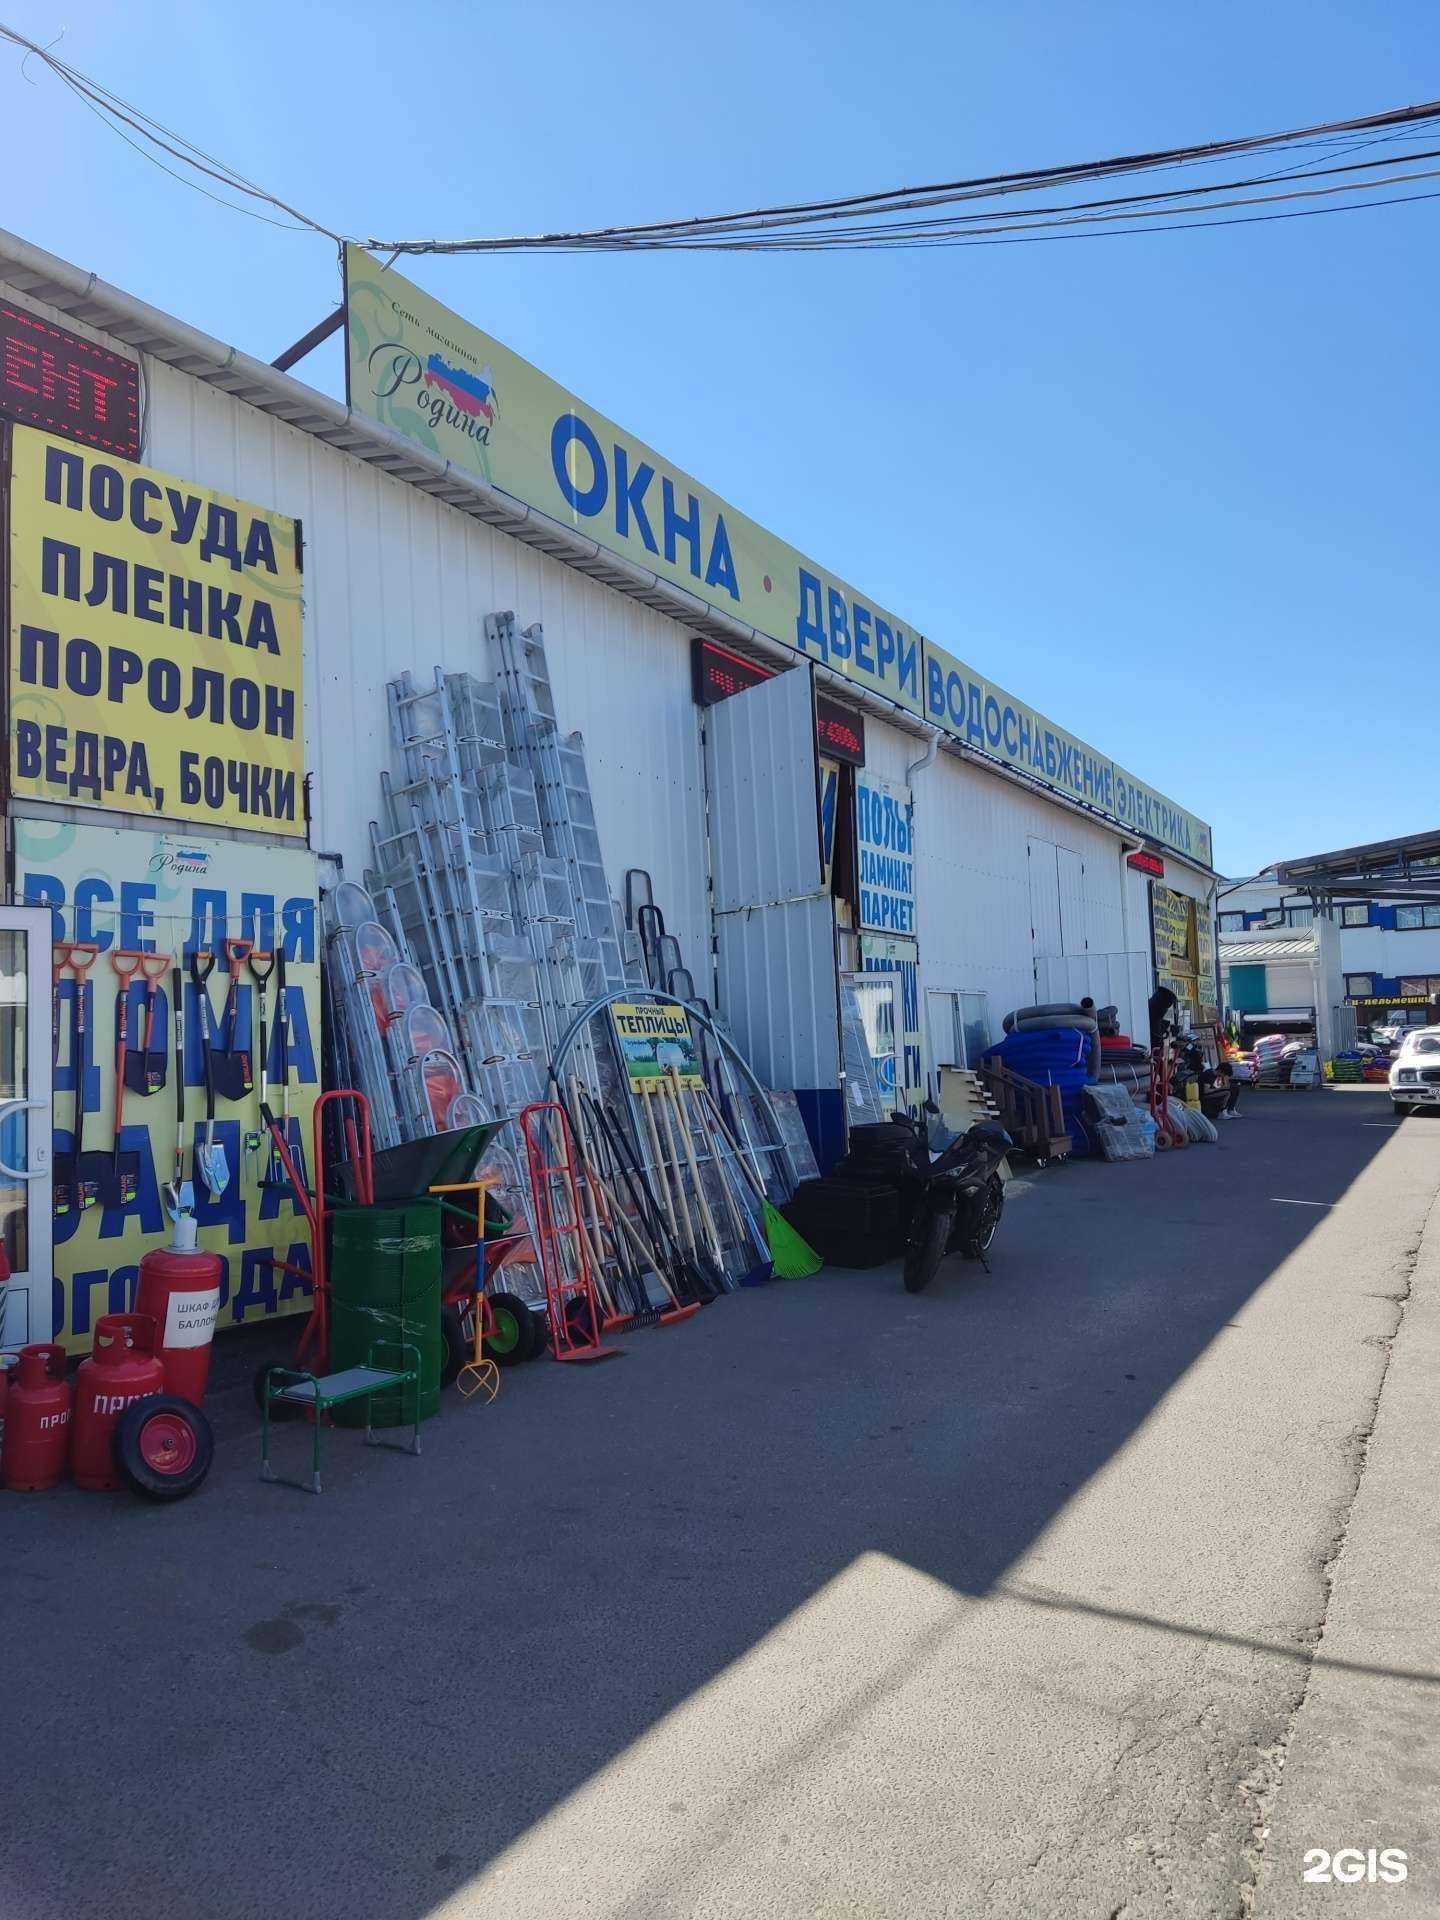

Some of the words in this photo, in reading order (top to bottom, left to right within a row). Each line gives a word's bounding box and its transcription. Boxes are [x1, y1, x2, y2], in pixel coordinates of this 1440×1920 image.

[367, 342, 492, 447] Родина
[44, 445, 279, 575] ПОСУДА
[41, 537, 281, 656] ПЛЕНКА
[550, 412, 741, 602] ОКНА
[796, 566, 918, 700] ДВЕРИ
[927, 655, 1113, 808] ВОДОСНАБЖЕНИЕ
[1115, 779, 1192, 853] ЭЛЕКТРИКА
[19, 624, 295, 740] ПОРОЛОН
[16, 719, 165, 811] ВЕДРА,
[179, 751, 296, 822] БОЧКИ
[857, 785, 912, 855] ПОЛЫ
[860, 849, 913, 894] ЛАМИНАТ
[860, 892, 914, 932] ПАРКЕТ
[23, 873, 157, 955] ВСЕ
[182, 888, 315, 973] ДЛЯ
[616, 1015, 689, 1037] ТЕПЛИЦЫ
[635, 1006, 665, 1016] ПРОЧНЫЕ
[177, 1302, 209, 1313] ШКАФ
